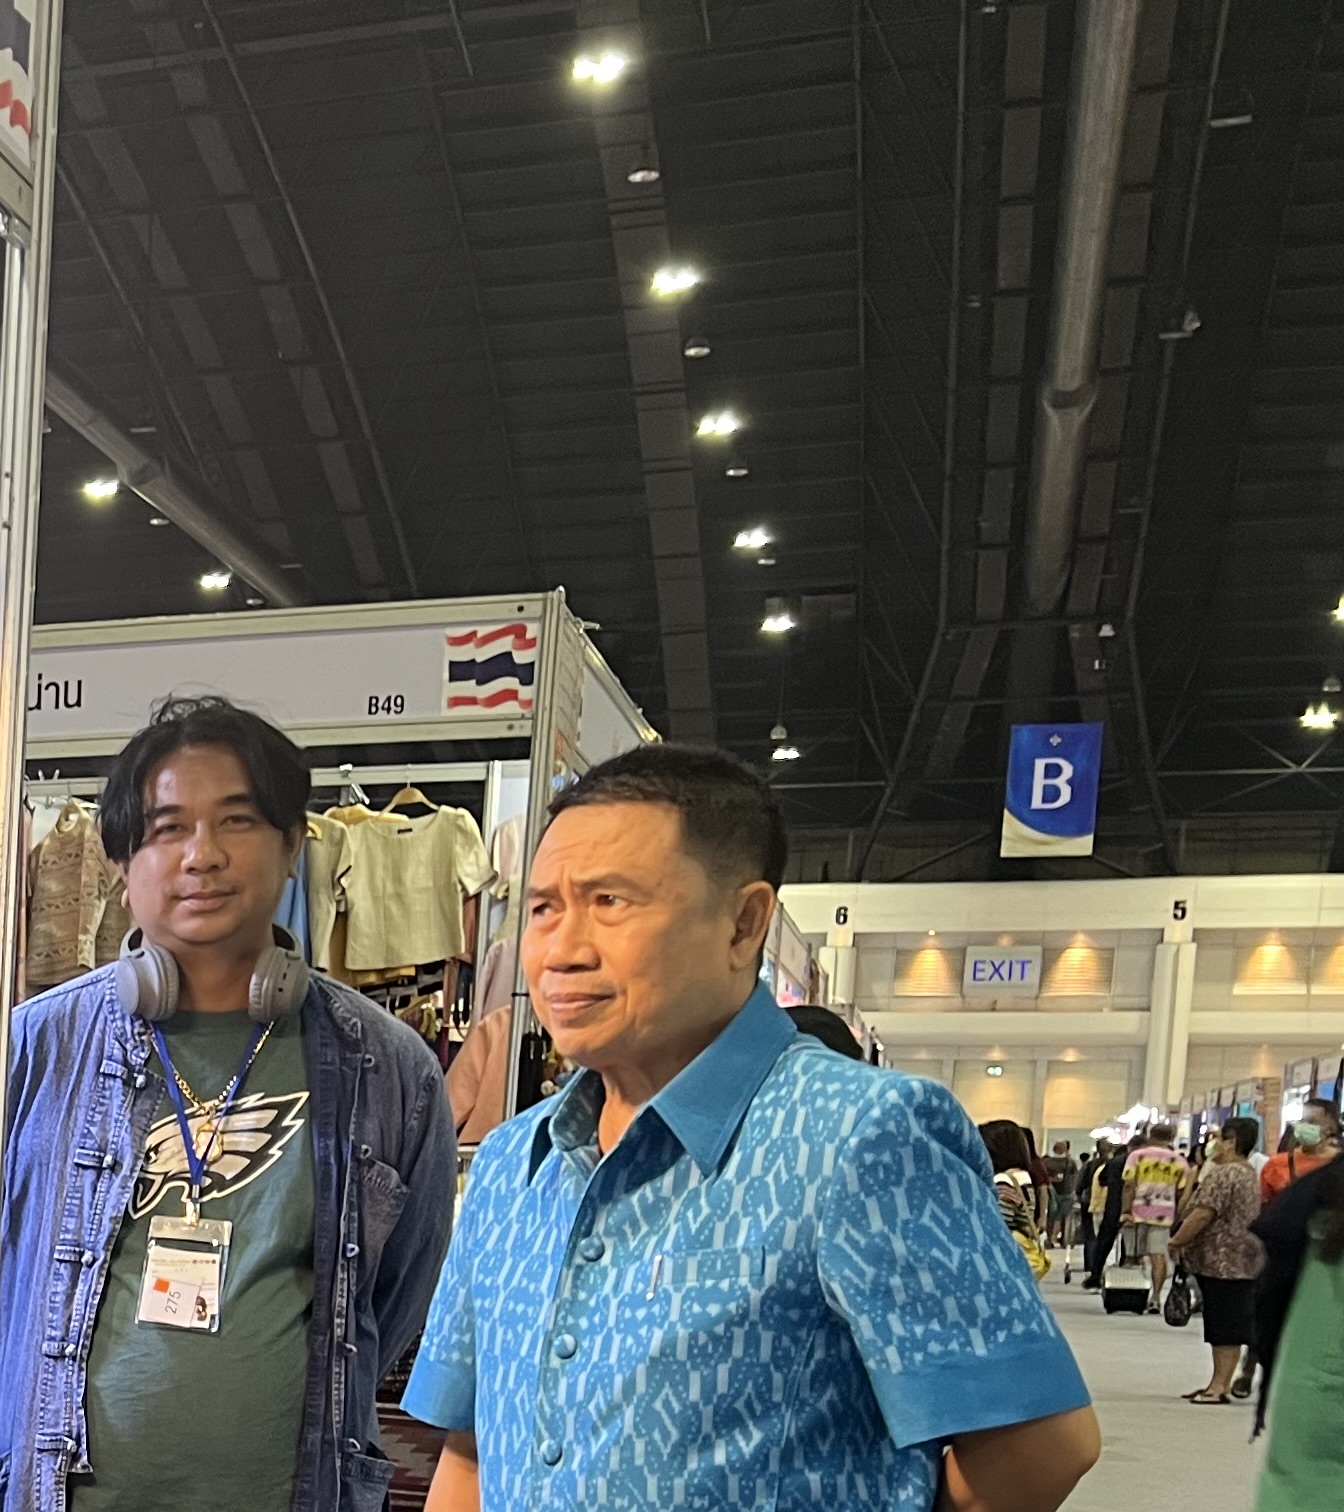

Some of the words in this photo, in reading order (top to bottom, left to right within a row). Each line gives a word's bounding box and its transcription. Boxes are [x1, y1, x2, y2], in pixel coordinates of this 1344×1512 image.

[367, 694, 406, 716] B49
[1029, 757, 1074, 811] B
[835, 906, 849, 925] 6
[1172, 900, 1188, 922] 5
[971, 958, 1033, 983] EXIT
[164, 1291, 182, 1315] 275
